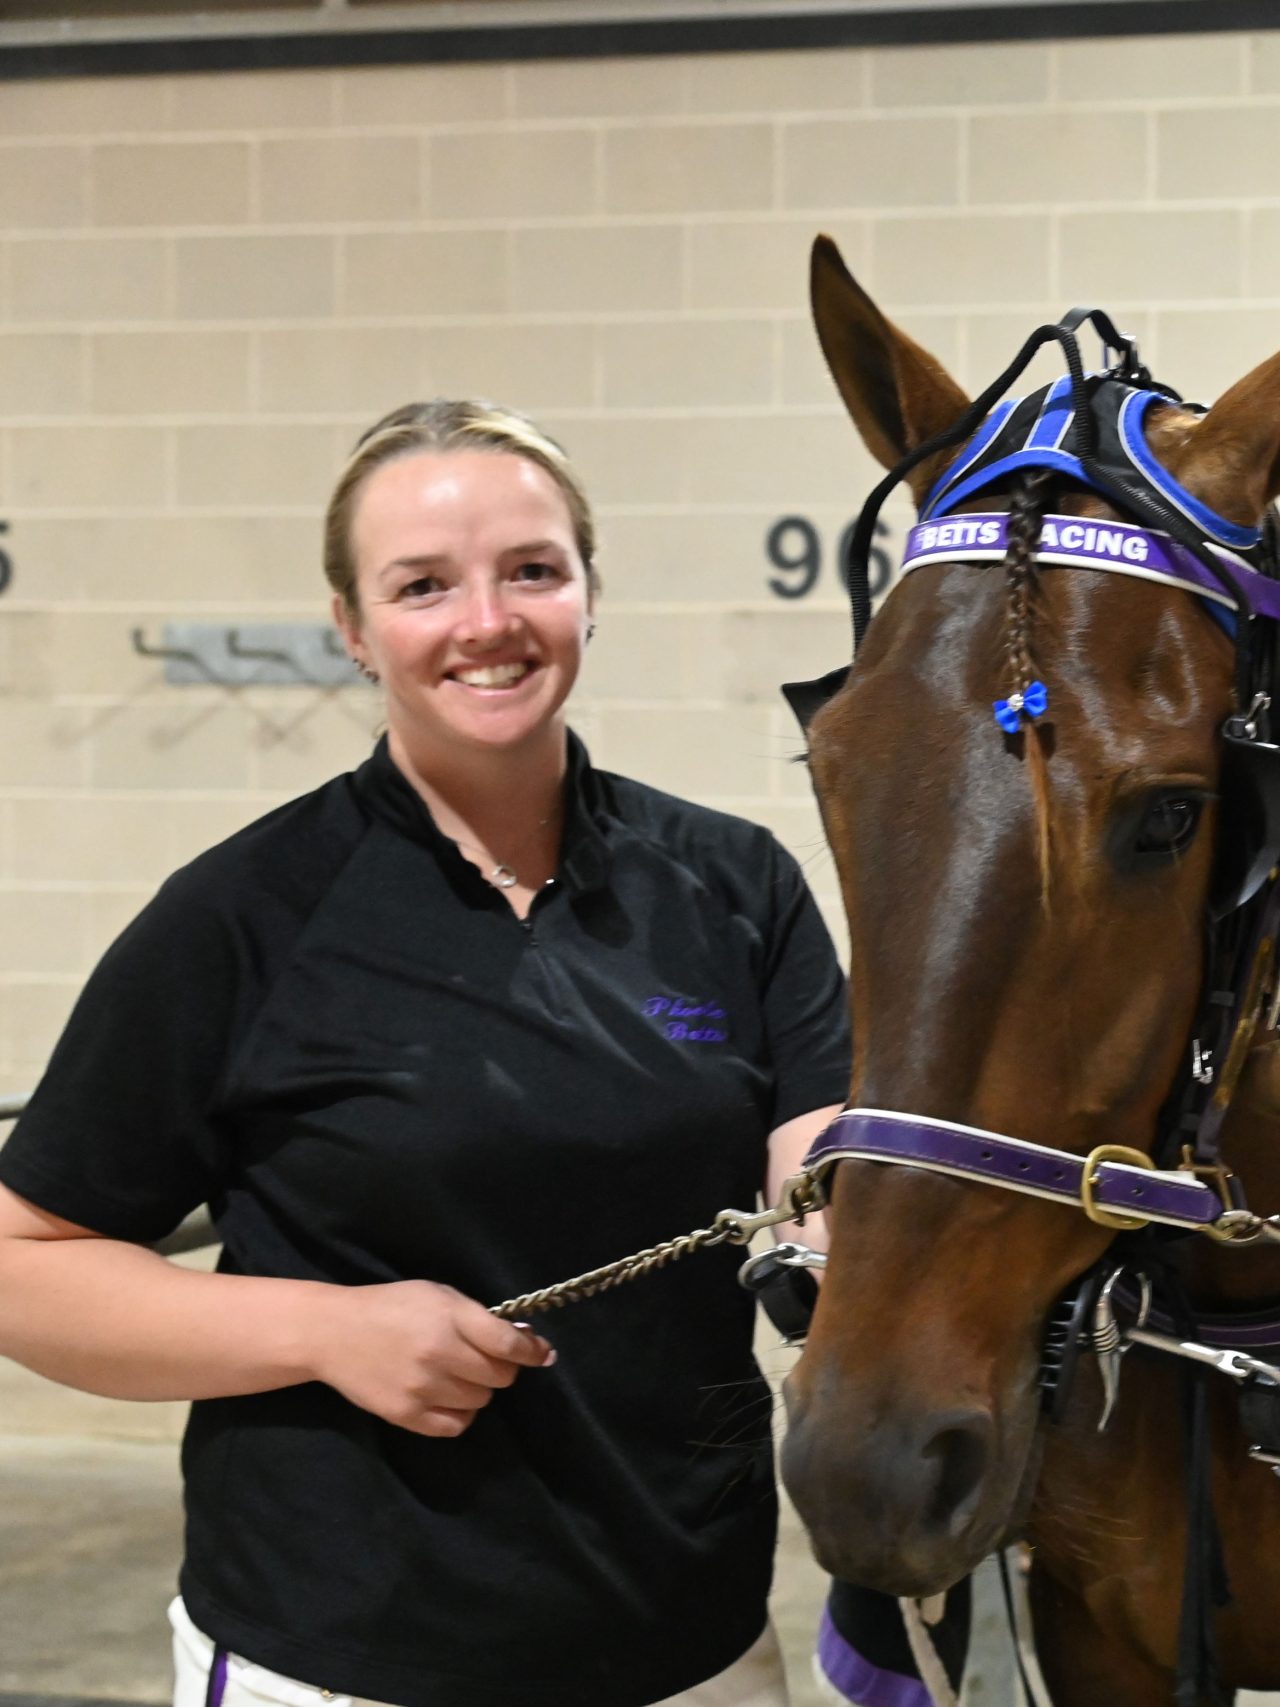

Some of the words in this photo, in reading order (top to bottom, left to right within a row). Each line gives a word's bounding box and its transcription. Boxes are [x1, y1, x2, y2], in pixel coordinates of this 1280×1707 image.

[766, 514, 892, 600] 96
[919, 521, 1001, 550] BETTS
[1040, 523, 1149, 561] ACING
